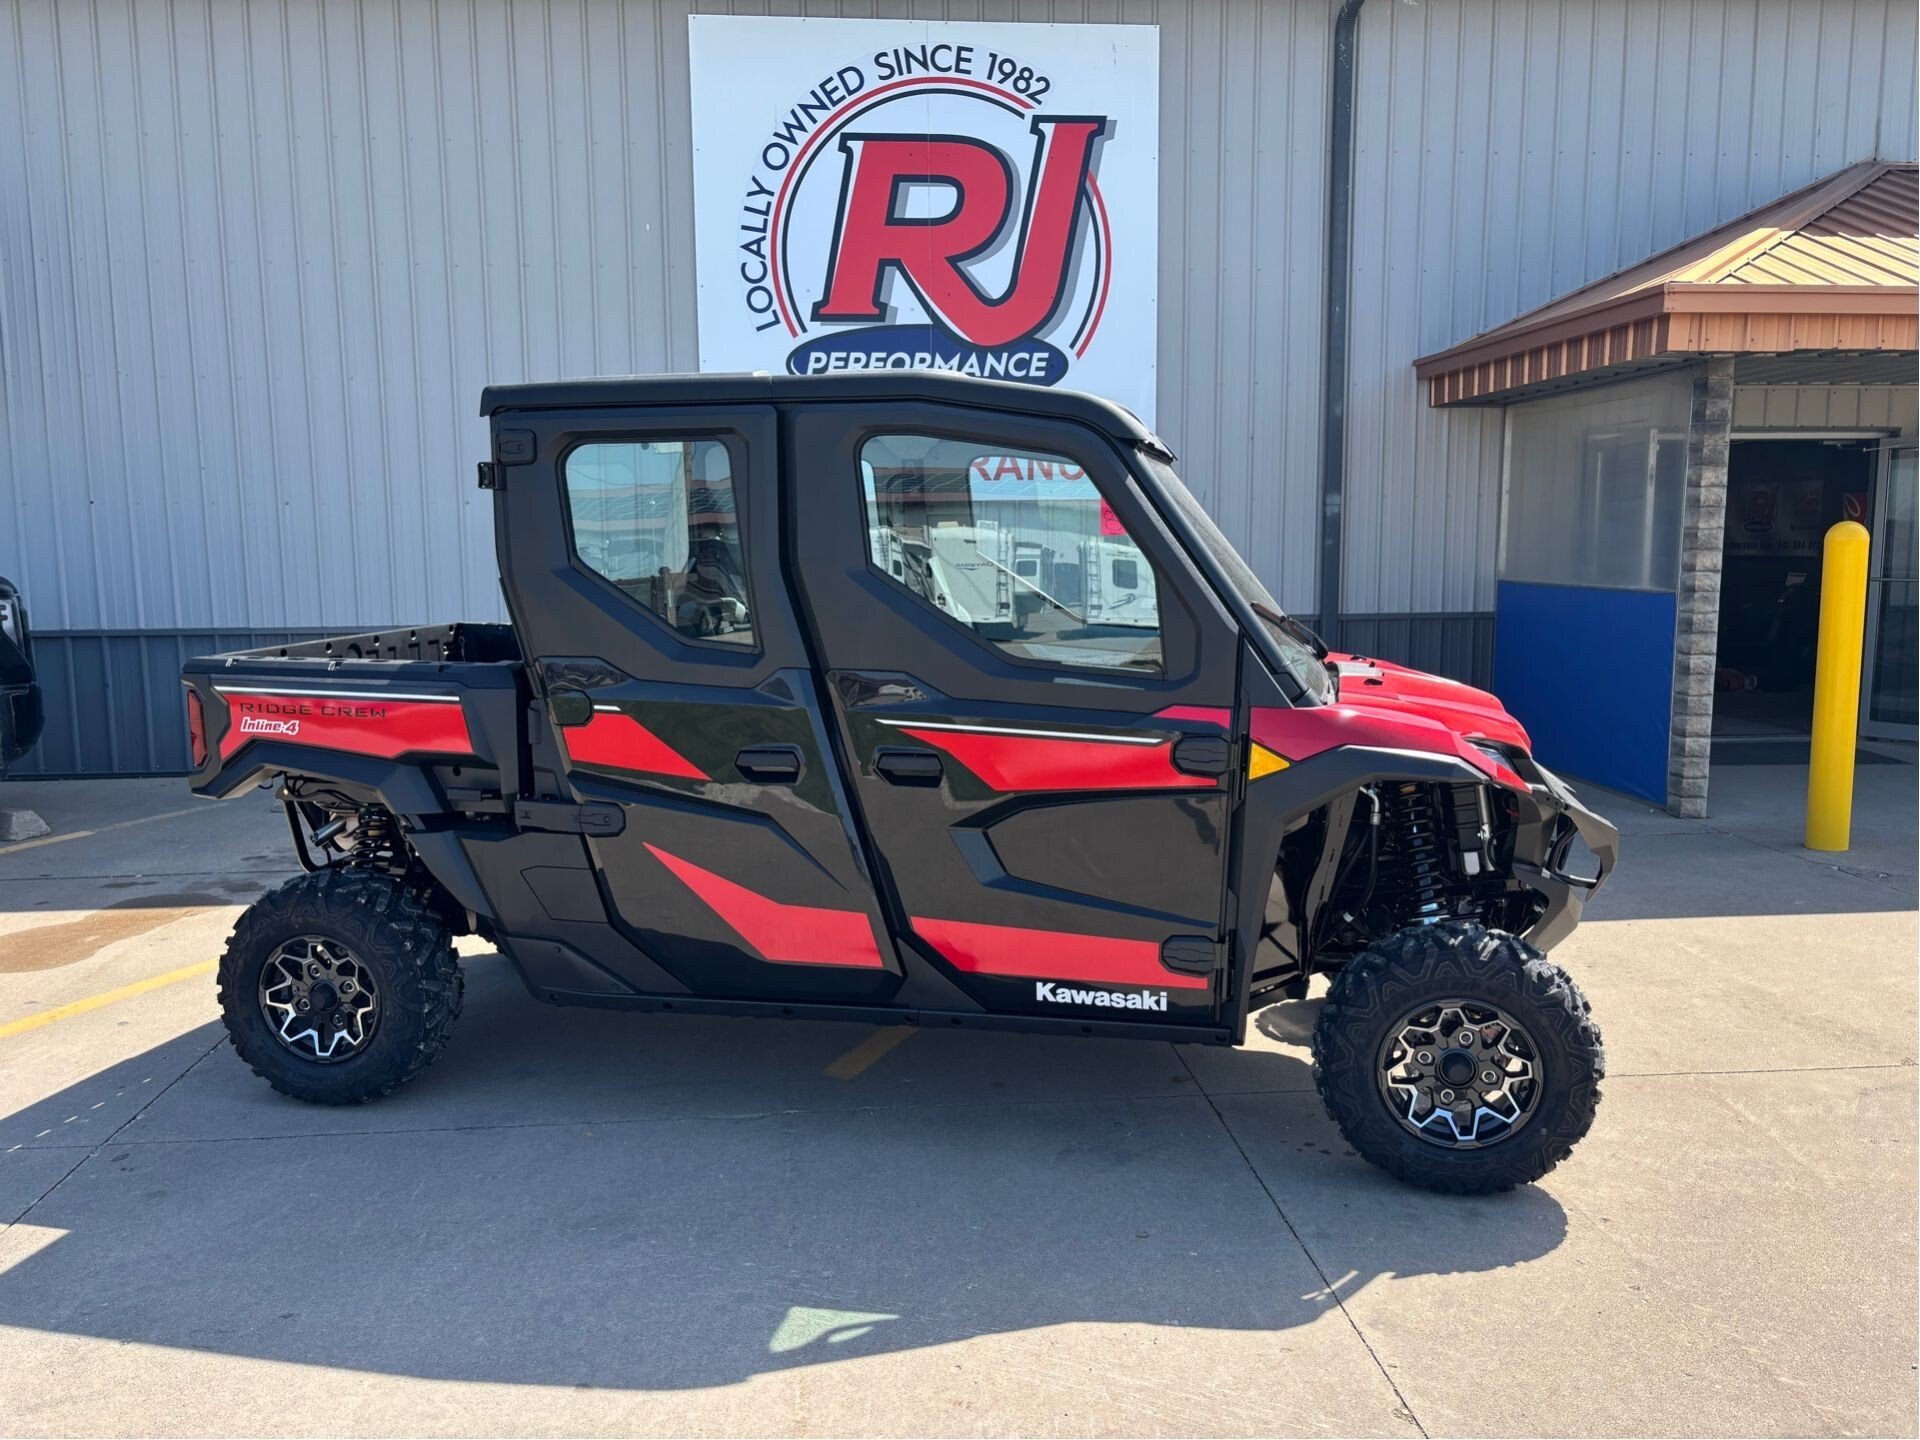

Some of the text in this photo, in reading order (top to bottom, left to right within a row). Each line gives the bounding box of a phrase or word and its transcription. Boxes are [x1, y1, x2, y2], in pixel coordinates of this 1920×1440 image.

[739, 43, 1052, 332] LOCALLY OWNED SINCE 1982
[811, 115, 1108, 348] RJ
[239, 702, 386, 719] RIDGE CREW
[1035, 981, 1168, 1012] Kawasaki
